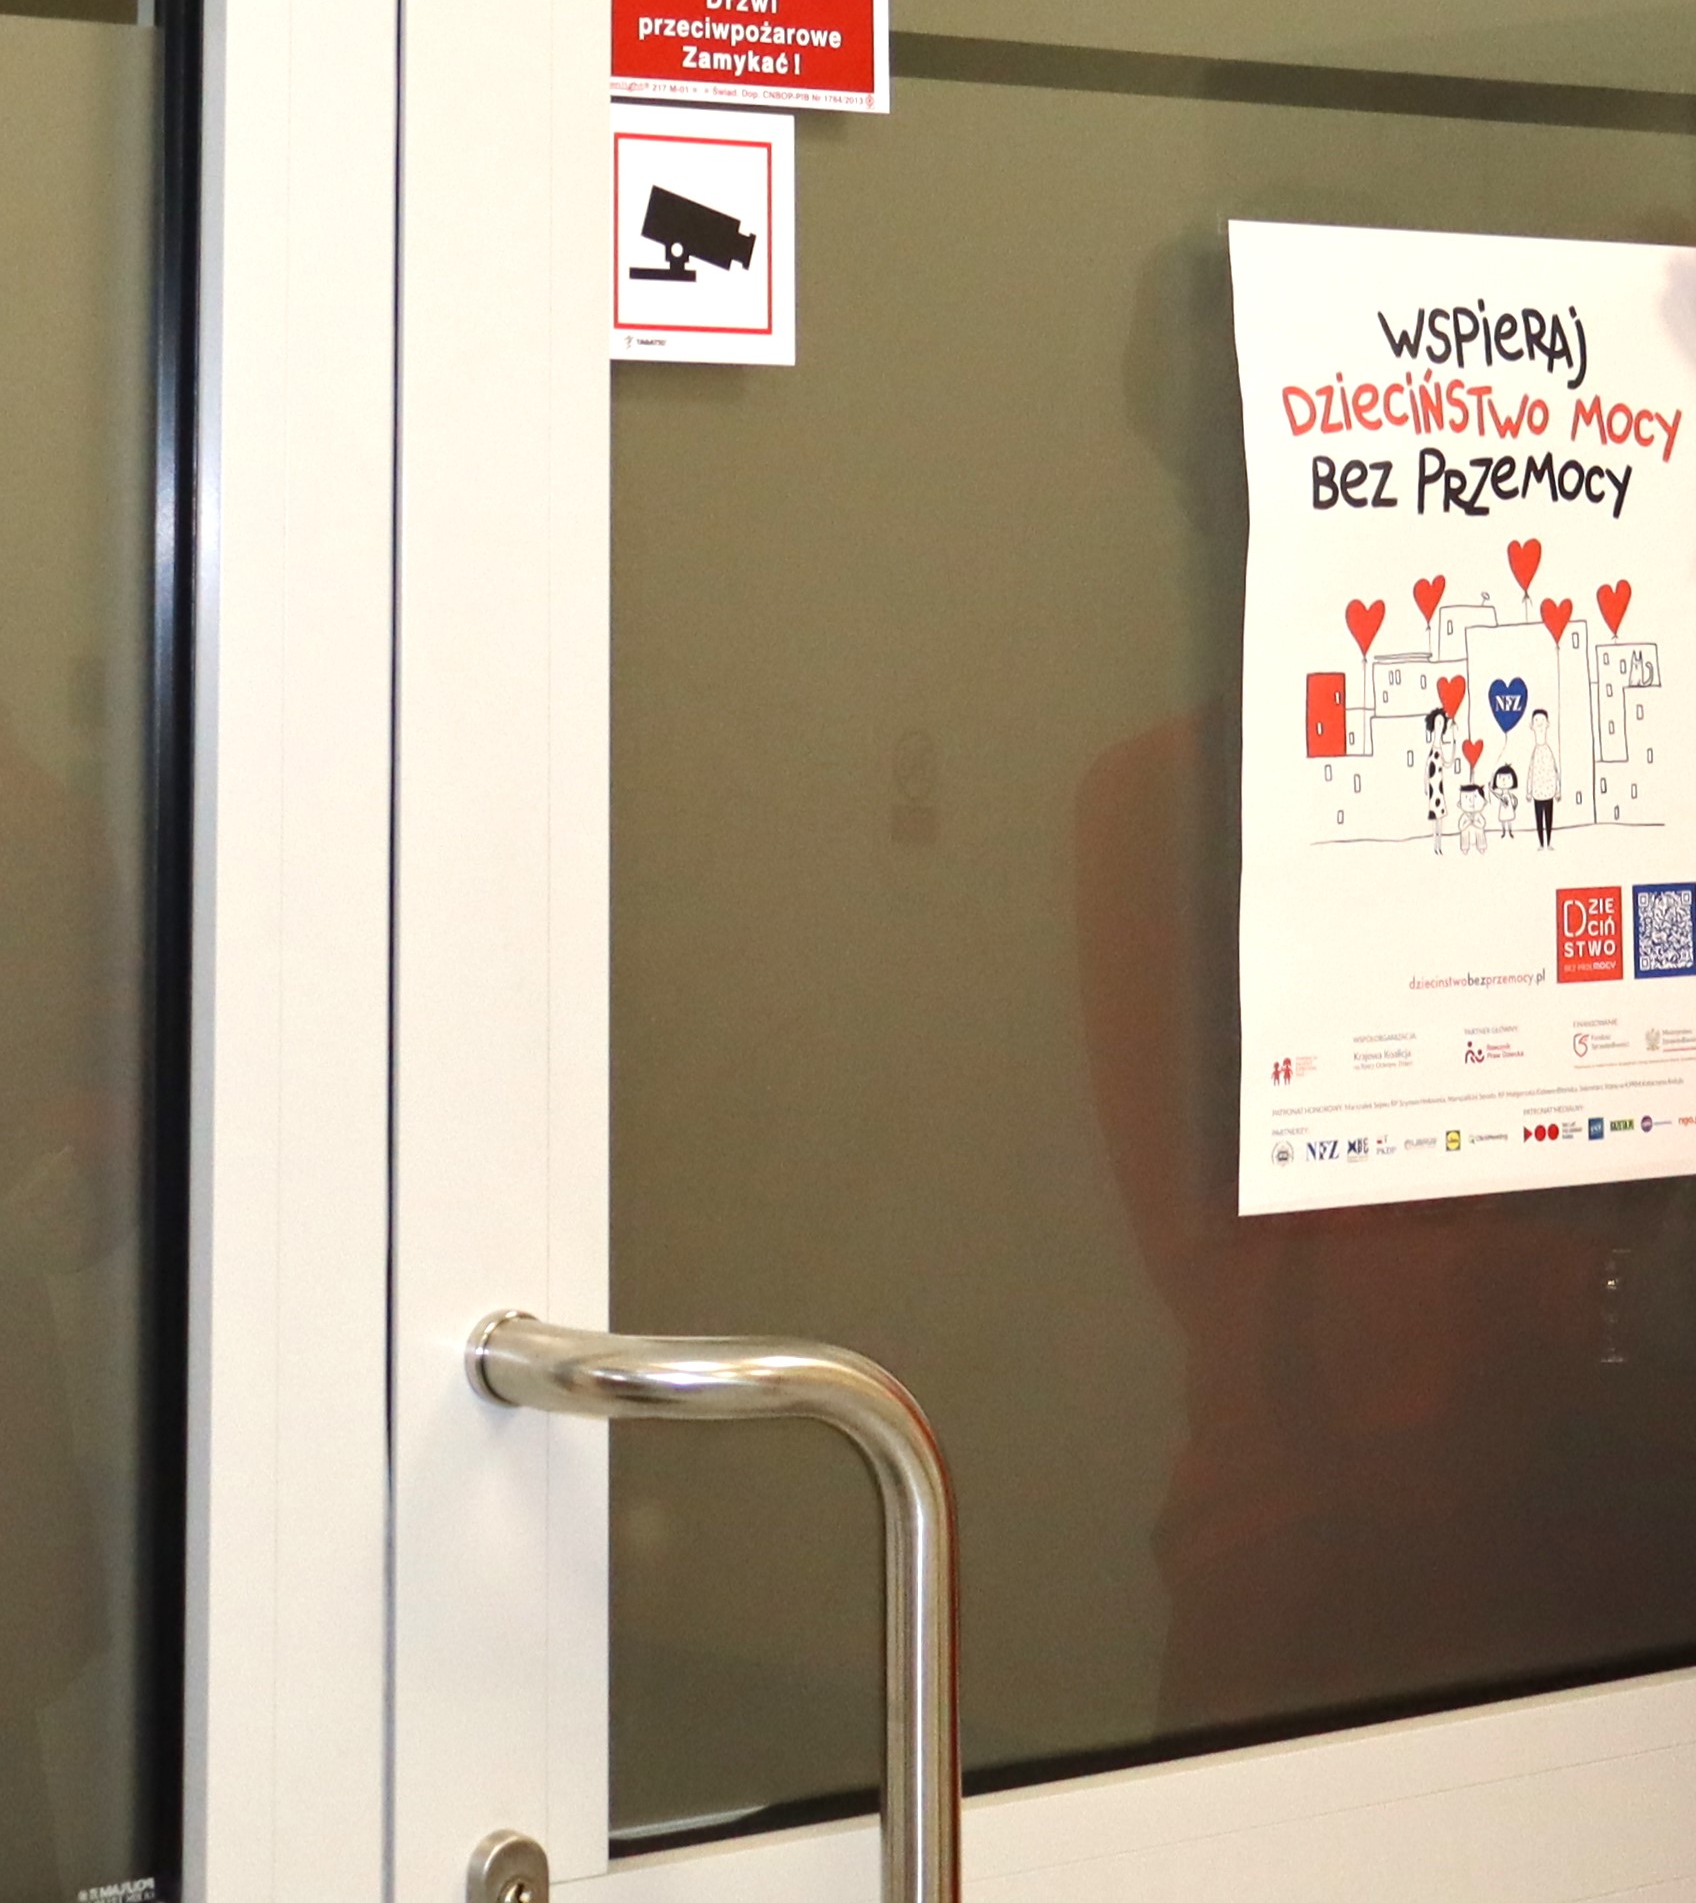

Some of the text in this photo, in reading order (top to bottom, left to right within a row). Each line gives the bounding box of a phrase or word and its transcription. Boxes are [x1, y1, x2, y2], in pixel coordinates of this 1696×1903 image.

[639, 16, 842, 48] przeciwpożarowe
[652, 84, 667, 92] 217
[1570, 394, 1682, 463] MOCY
[1495, 695, 1521, 711] NFZ
[1306, 1139, 1340, 1162] NFZ
